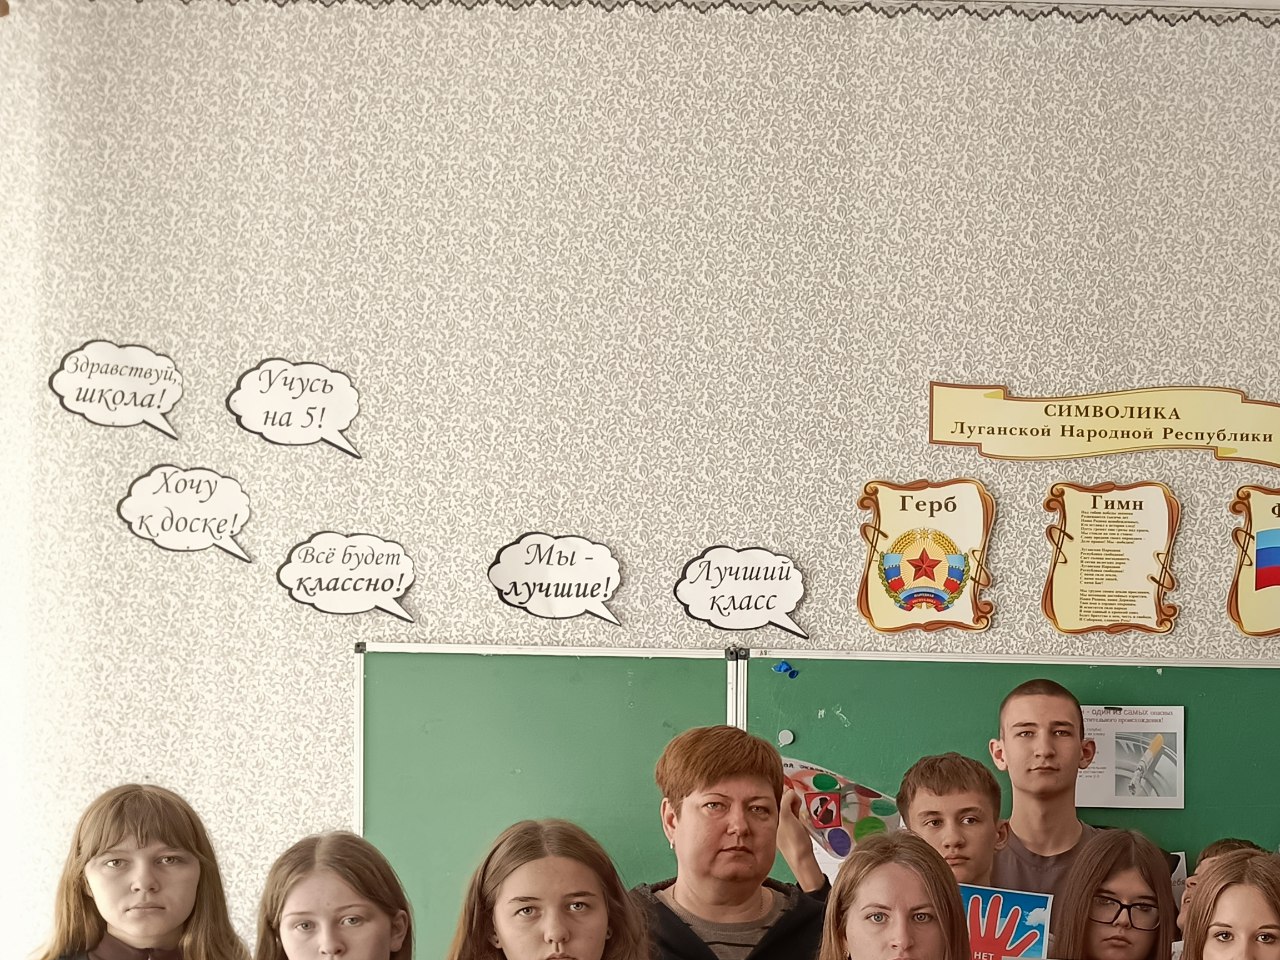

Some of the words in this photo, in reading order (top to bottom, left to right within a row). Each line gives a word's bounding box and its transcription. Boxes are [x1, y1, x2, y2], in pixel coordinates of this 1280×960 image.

[66, 356, 176, 385] Здравствуй,
[258, 368, 334, 399] Учусь
[75, 387, 166, 412] школа!
[263, 410, 292, 427] на
[301, 406, 326, 428] 5!
[1044, 404, 1181, 420] СИМВОЛИКА
[951, 421, 1051, 438] Луганской
[1060, 424, 1153, 442] Народной
[1162, 427, 1273, 445] Республики
[152, 470, 218, 503] Хочу
[899, 495, 957, 518] Герб
[1091, 494, 1144, 511] Гимн
[138, 514, 159, 538] к
[161, 506, 238, 540] доске!
[298, 546, 336, 564] Всё
[341, 545, 401, 571] будет
[525, 543, 576, 567] Мы
[296, 573, 405, 597] классно!
[689, 560, 791, 589] Лучший
[503, 576, 611, 605] лучшие!
[709, 594, 777, 617] класс
